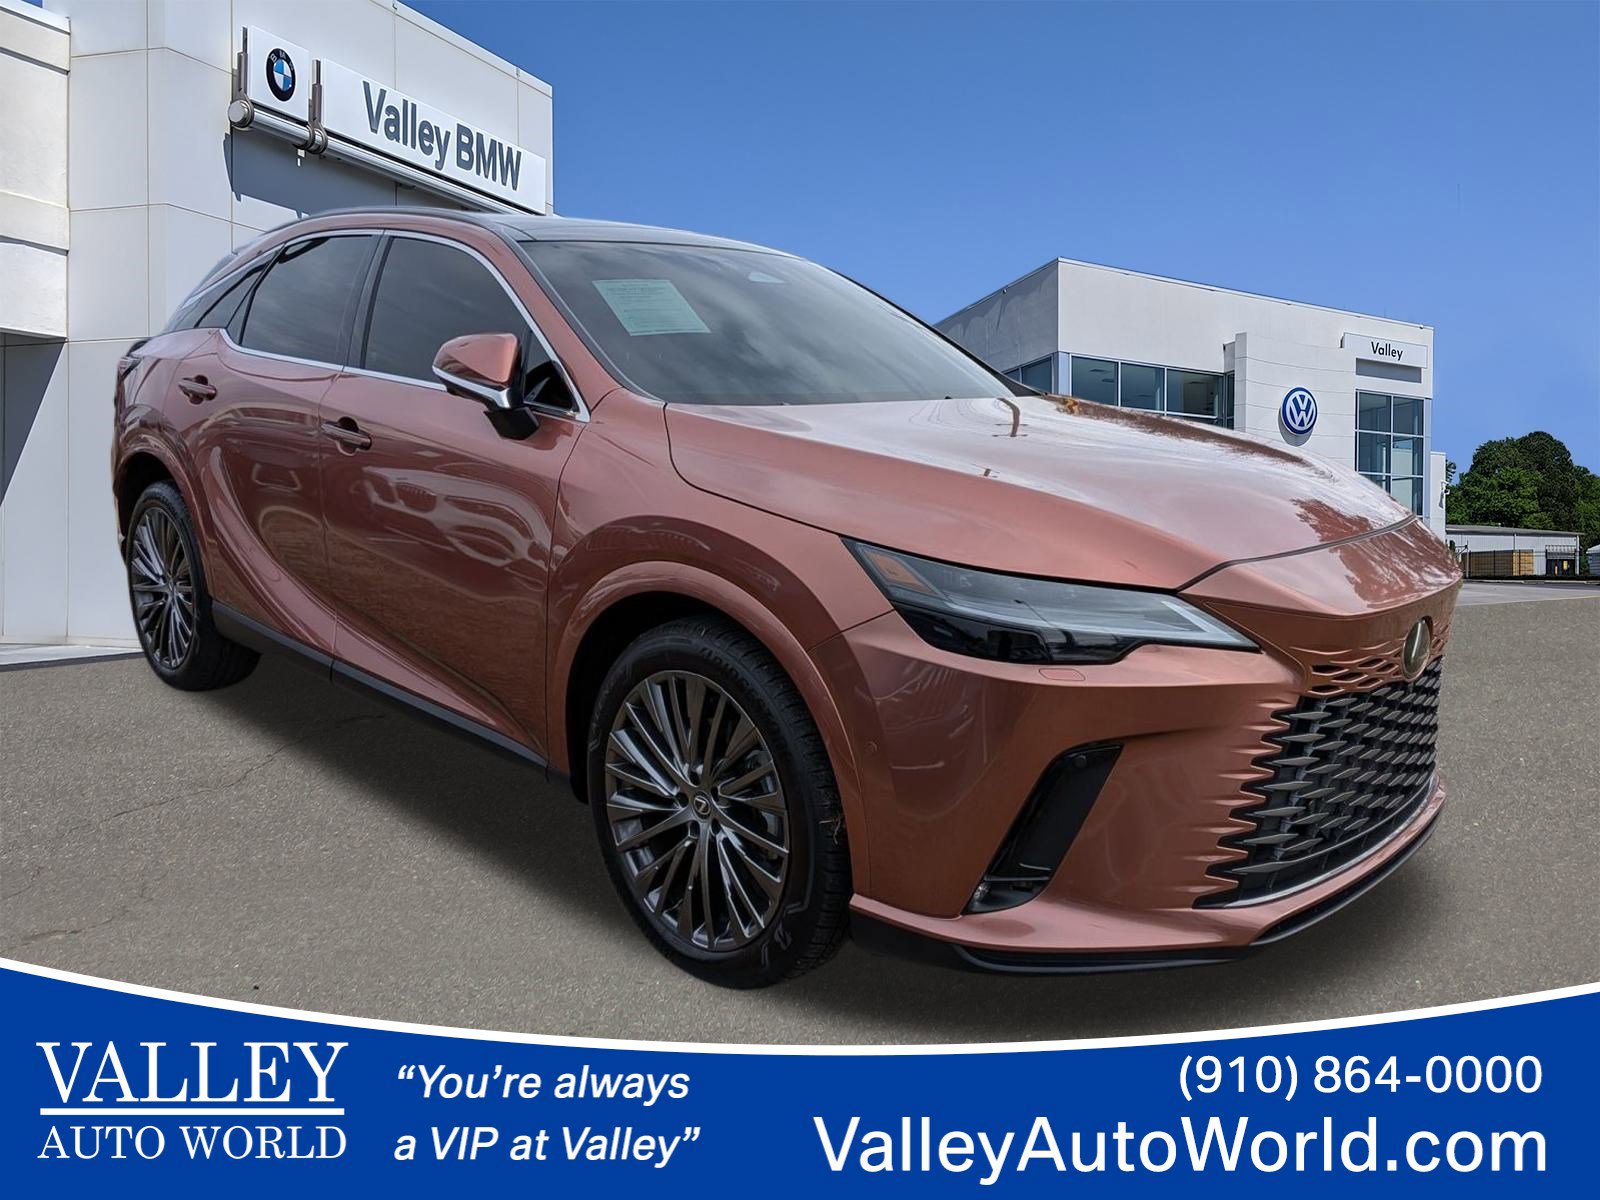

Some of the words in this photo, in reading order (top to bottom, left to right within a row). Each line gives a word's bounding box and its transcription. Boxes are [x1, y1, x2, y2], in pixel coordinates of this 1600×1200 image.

[362, 80, 450, 171] Valley
[456, 123, 522, 191] BMW
[1371, 341, 1404, 361] Valley
[1286, 390, 1316, 431] VW
